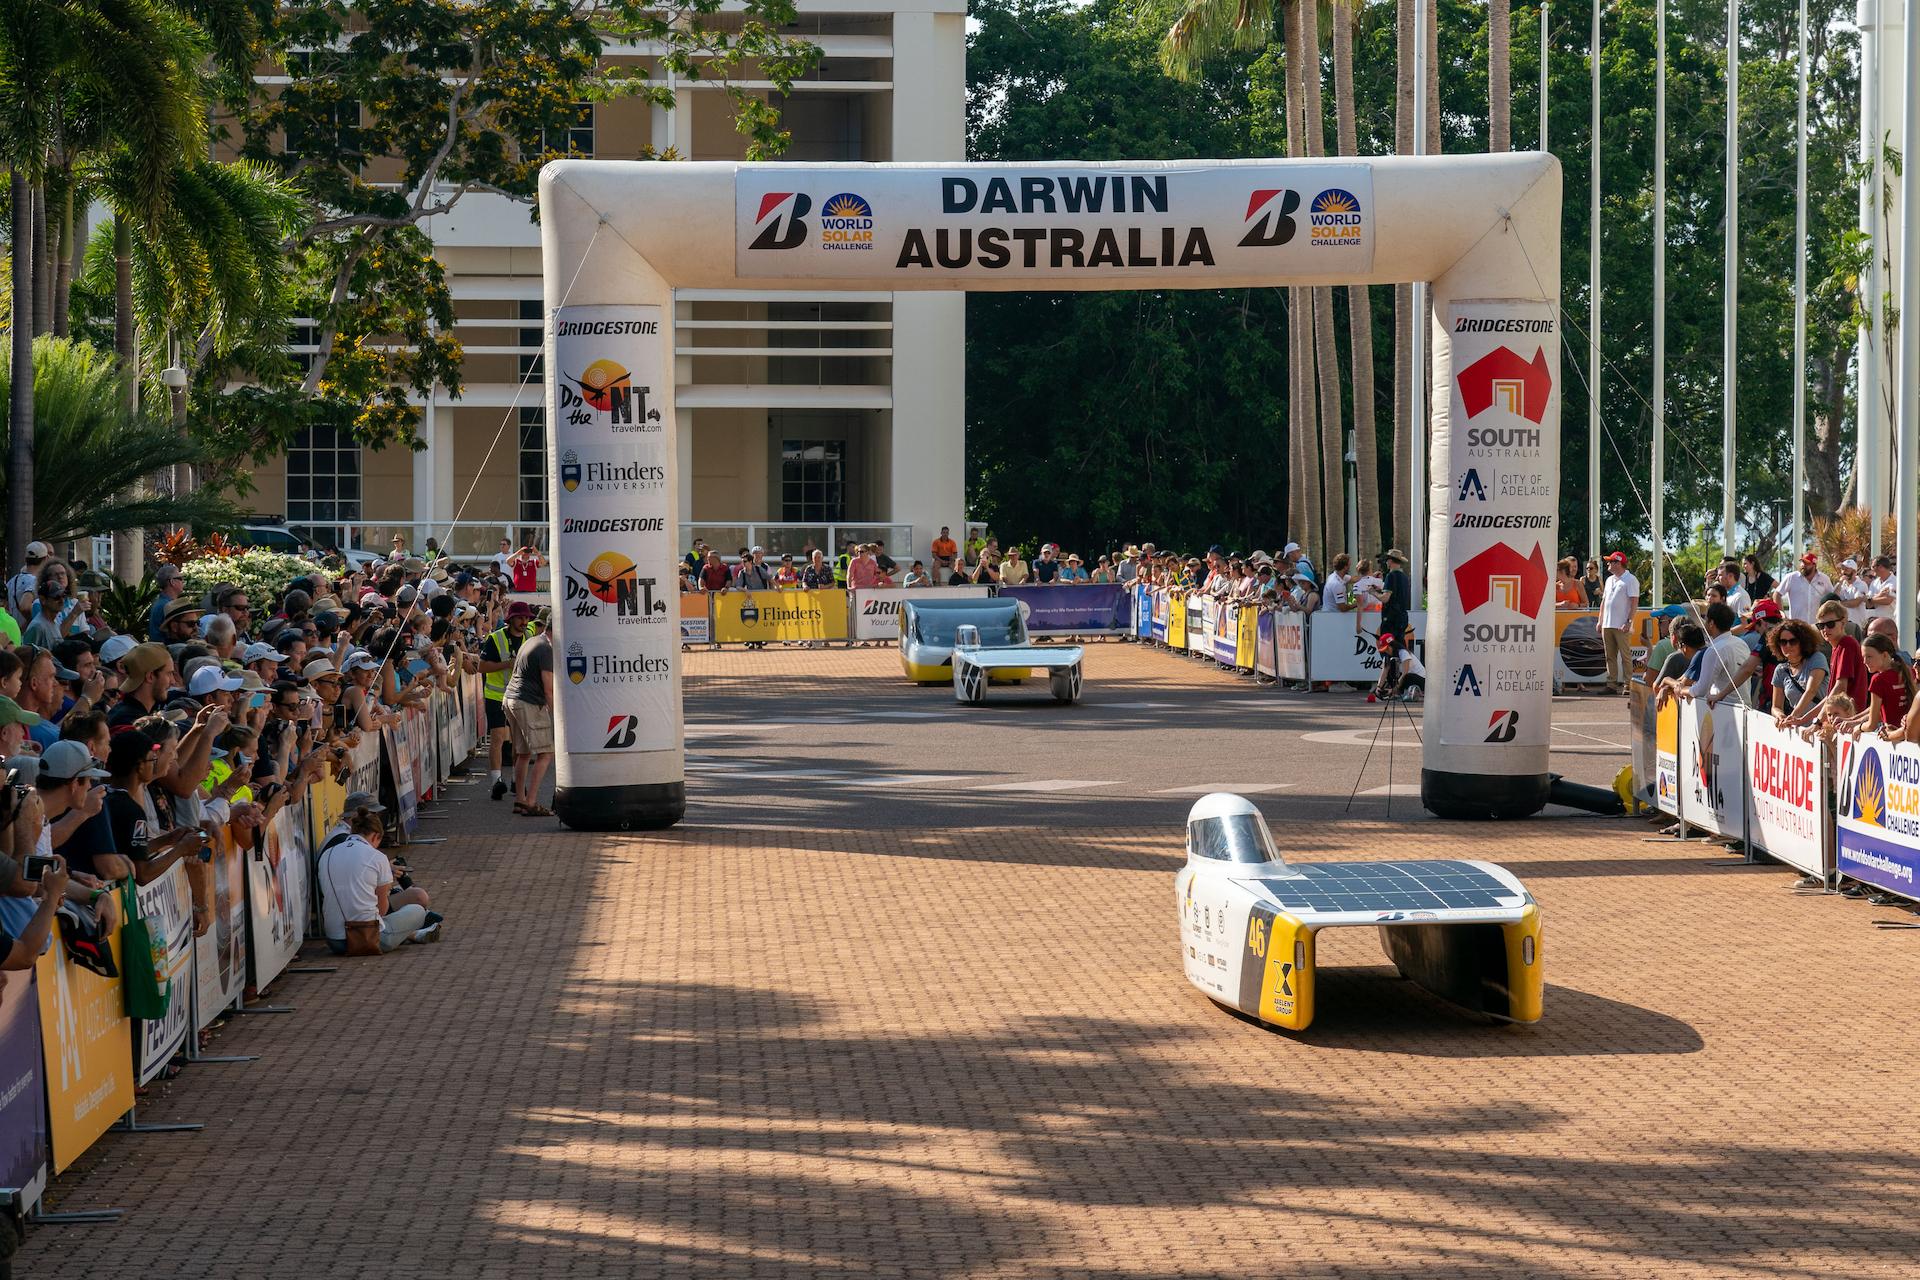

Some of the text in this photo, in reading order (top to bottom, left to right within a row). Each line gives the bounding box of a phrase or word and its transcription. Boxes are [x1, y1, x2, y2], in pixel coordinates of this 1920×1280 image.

[942, 175, 1168, 213] DARWIN
[822, 218, 873, 230] WORLD
[1310, 214, 1361, 226] WORLD
[822, 230, 873, 242] SOLAR
[1311, 226, 1361, 238] SOLAR
[896, 227, 1216, 269] AUSTRALIA
[1311, 238, 1361, 246] CHALLENGE
[558, 321, 658, 336] BRIDGESTONE
[1455, 317, 1554, 333] BRIDGESTONE
[560, 384, 583, 409] Do
[610, 386, 650, 424] NT
[566, 410, 592, 426] the
[611, 425, 662, 433] travelnt.com
[1467, 428, 1540, 447] SOUTH
[1468, 449, 1540, 458] AUSTRALIA
[587, 461, 664, 482] Flinders
[1501, 474, 1542, 485] CITY OF
[587, 482, 664, 491] UNIVERSITY
[1501, 485, 1550, 496] ADELAIDE
[563, 518, 664, 533] BRIDGESTONE
[1453, 513, 1552, 529] BRIDGESTONE
[565, 576, 589, 600] Do
[617, 578, 656, 616] NT
[572, 601, 599, 617] the
[763, 606, 821, 621] Flinders
[617, 616, 667, 625] travelnt.com
[1463, 624, 1536, 642] SOUTH
[1464, 644, 1536, 653] AUSTRALIA
[592, 654, 669, 674] Flinders
[1360, 656, 1383, 670] the
[593, 673, 669, 684] UNIVERSITY
[1496, 669, 1537, 680] CITY OF
[1496, 680, 1544, 691] ADELAIDE
[1753, 741, 1813, 812] ADELAIDE
[1889, 753, 1920, 785] WORLD
[1887, 783, 1920, 816] SOLAR
[1753, 796, 1774, 826] SOUTH
[1776, 804, 1815, 841] AUSTRALIA
[1887, 815, 1920, 838] CHALLENGE
[1841, 845, 1912, 883] www.worldsolarchallenge.org
[1249, 917, 1265, 958] 46
[1276, 1006, 1293, 1015] GROUP
